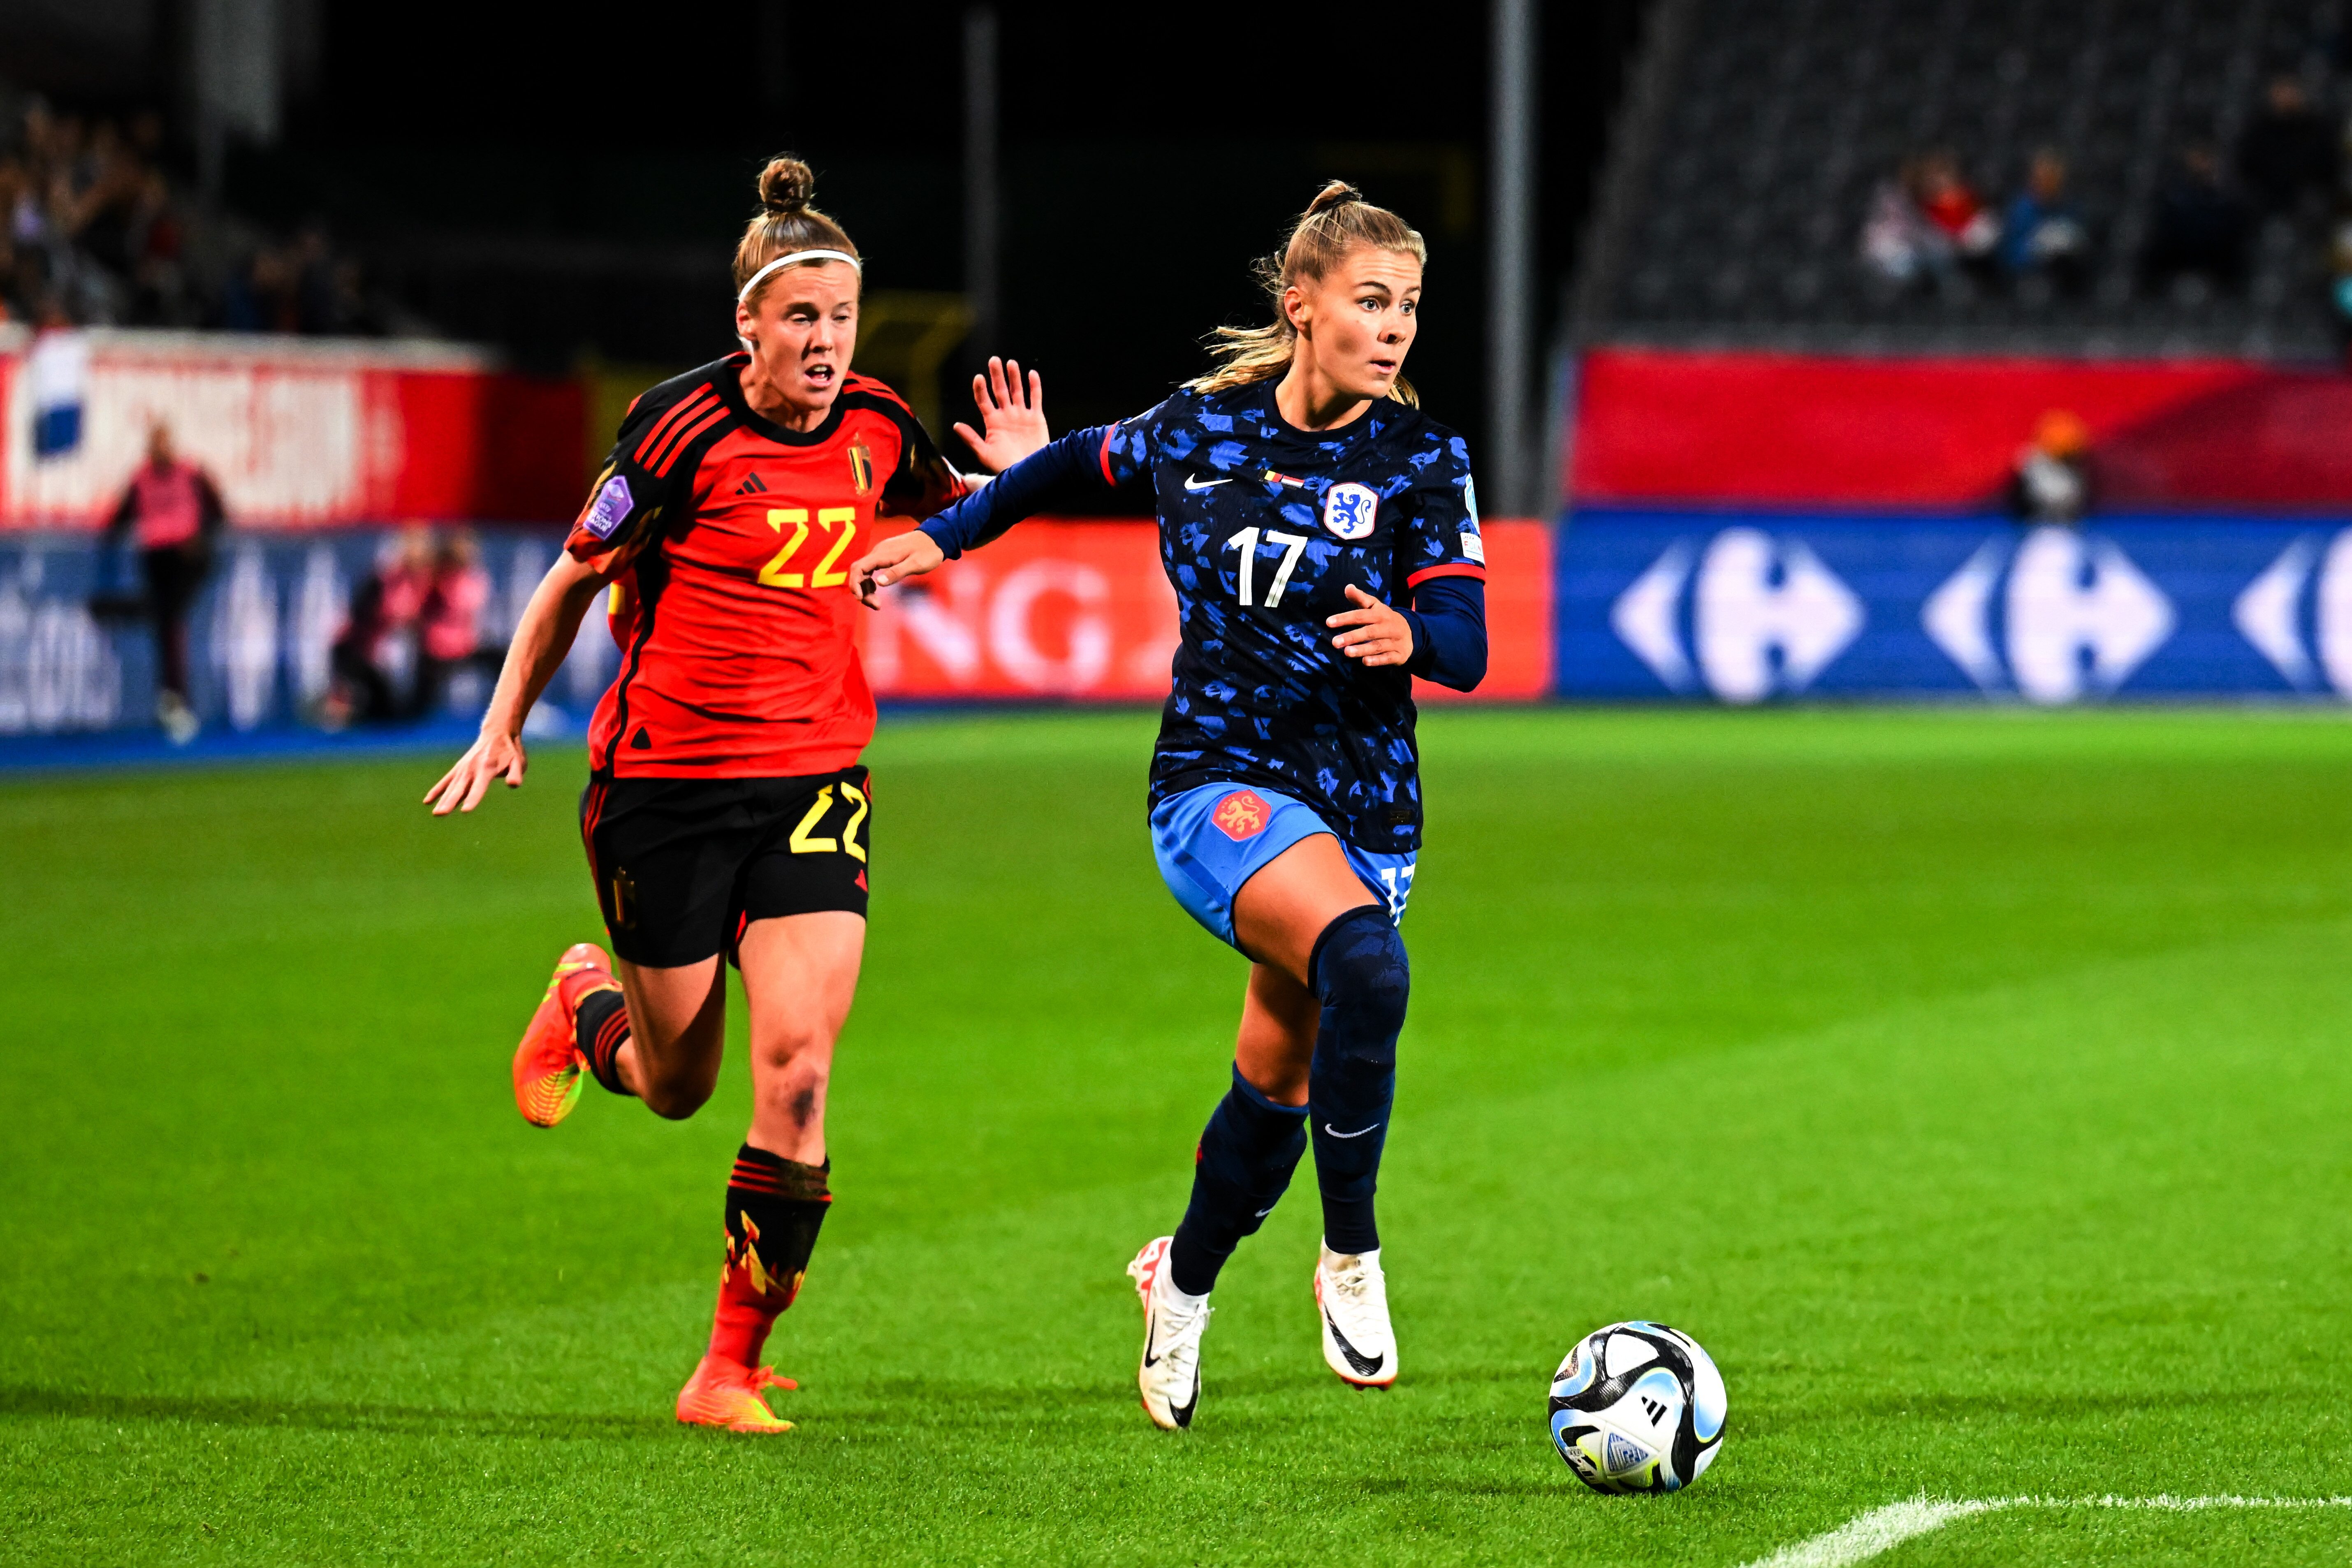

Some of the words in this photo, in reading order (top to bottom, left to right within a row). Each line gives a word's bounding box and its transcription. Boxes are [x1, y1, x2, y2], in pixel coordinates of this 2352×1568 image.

[758, 507, 856, 588] 22
[1228, 526, 1308, 608] 17
[864, 555, 1110, 689] NG
[789, 782, 868, 863] 22
[1381, 862, 1416, 927] 17
